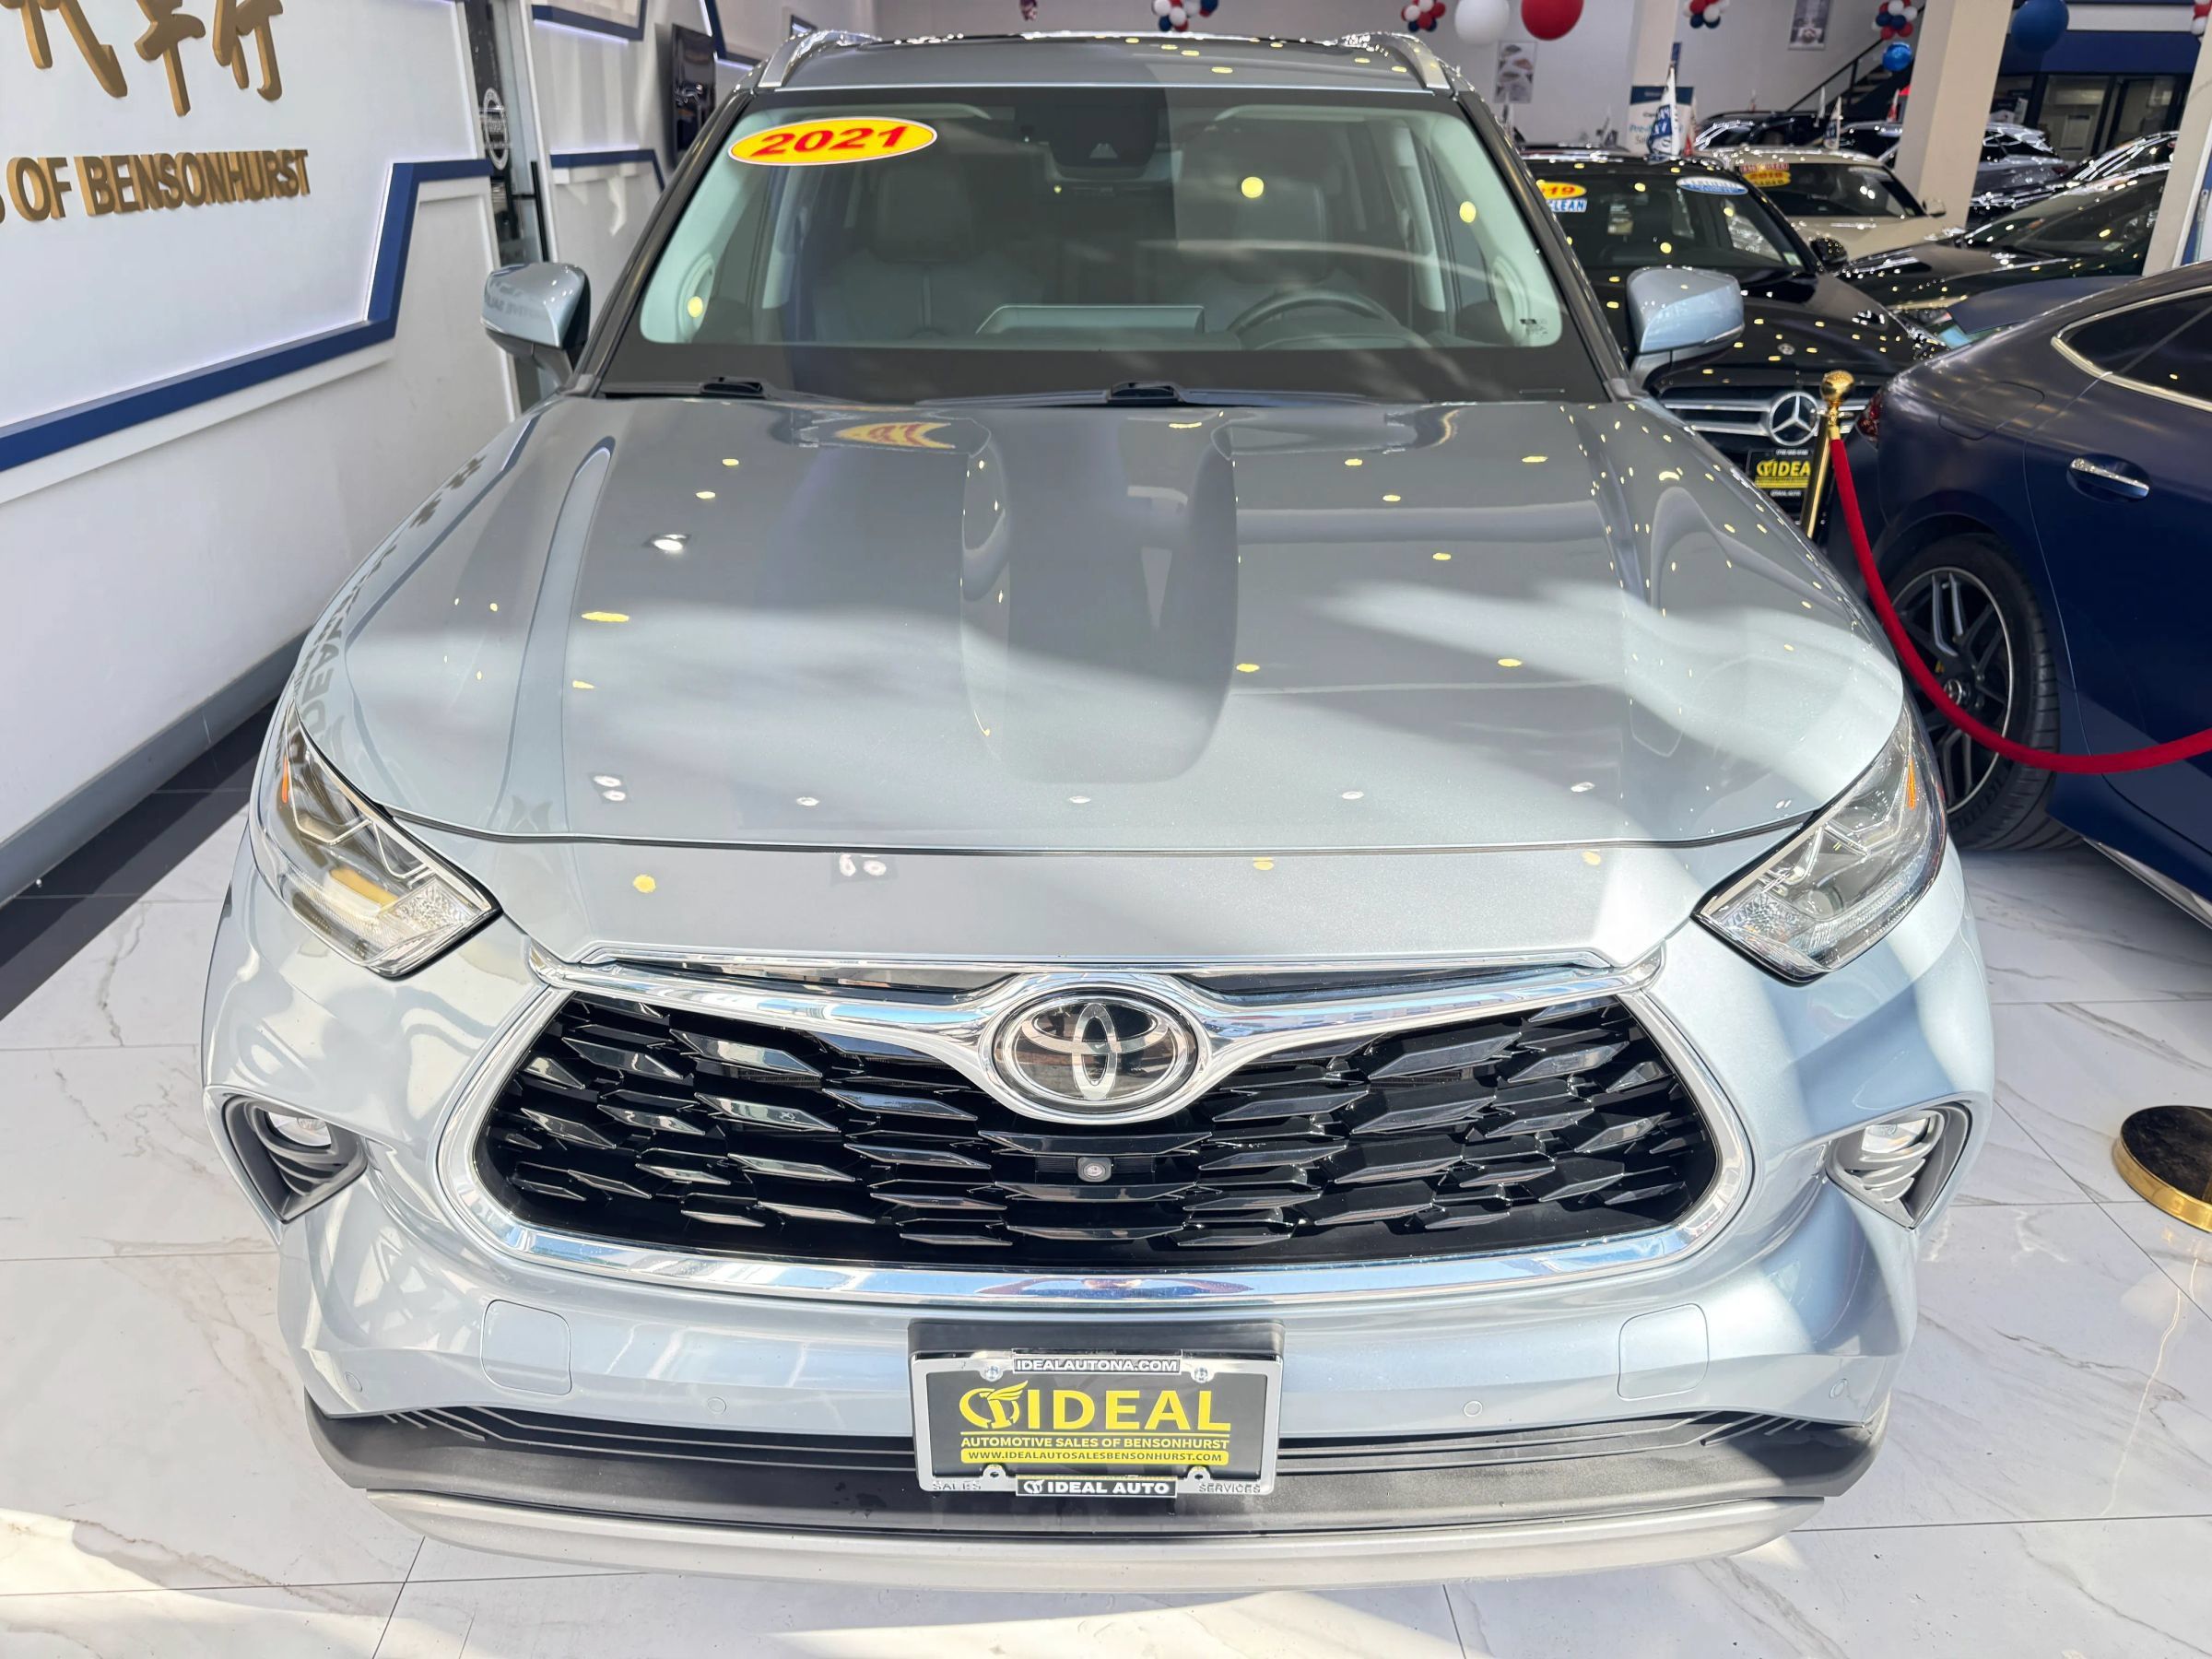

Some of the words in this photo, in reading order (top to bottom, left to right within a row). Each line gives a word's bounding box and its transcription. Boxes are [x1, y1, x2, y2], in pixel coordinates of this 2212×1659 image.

[750, 125, 909, 158] 2021
[6, 156, 72, 222] OF
[74, 149, 311, 218] BENSONHURST
[1772, 460, 1811, 477] IDEA
[1016, 1359, 1178, 1372] IDEALAUTONA.COM
[1027, 1389, 1231, 1432] IDEAL
[960, 1437, 1053, 1449] AUTOMOTIVE
[1056, 1438, 1099, 1449] SALES
[1101, 1438, 1121, 1449] OF
[1124, 1438, 1230, 1451] BENSONHURST
[968, 1451, 1222, 1463] WWW.IDEALAUTOSALESBENSONHURST.COM
[933, 1480, 982, 1490] SALES
[1047, 1481, 1107, 1494] IDEAL
[1112, 1482, 1171, 1495] AUTO
[1199, 1483, 1262, 1494] SERVICES
